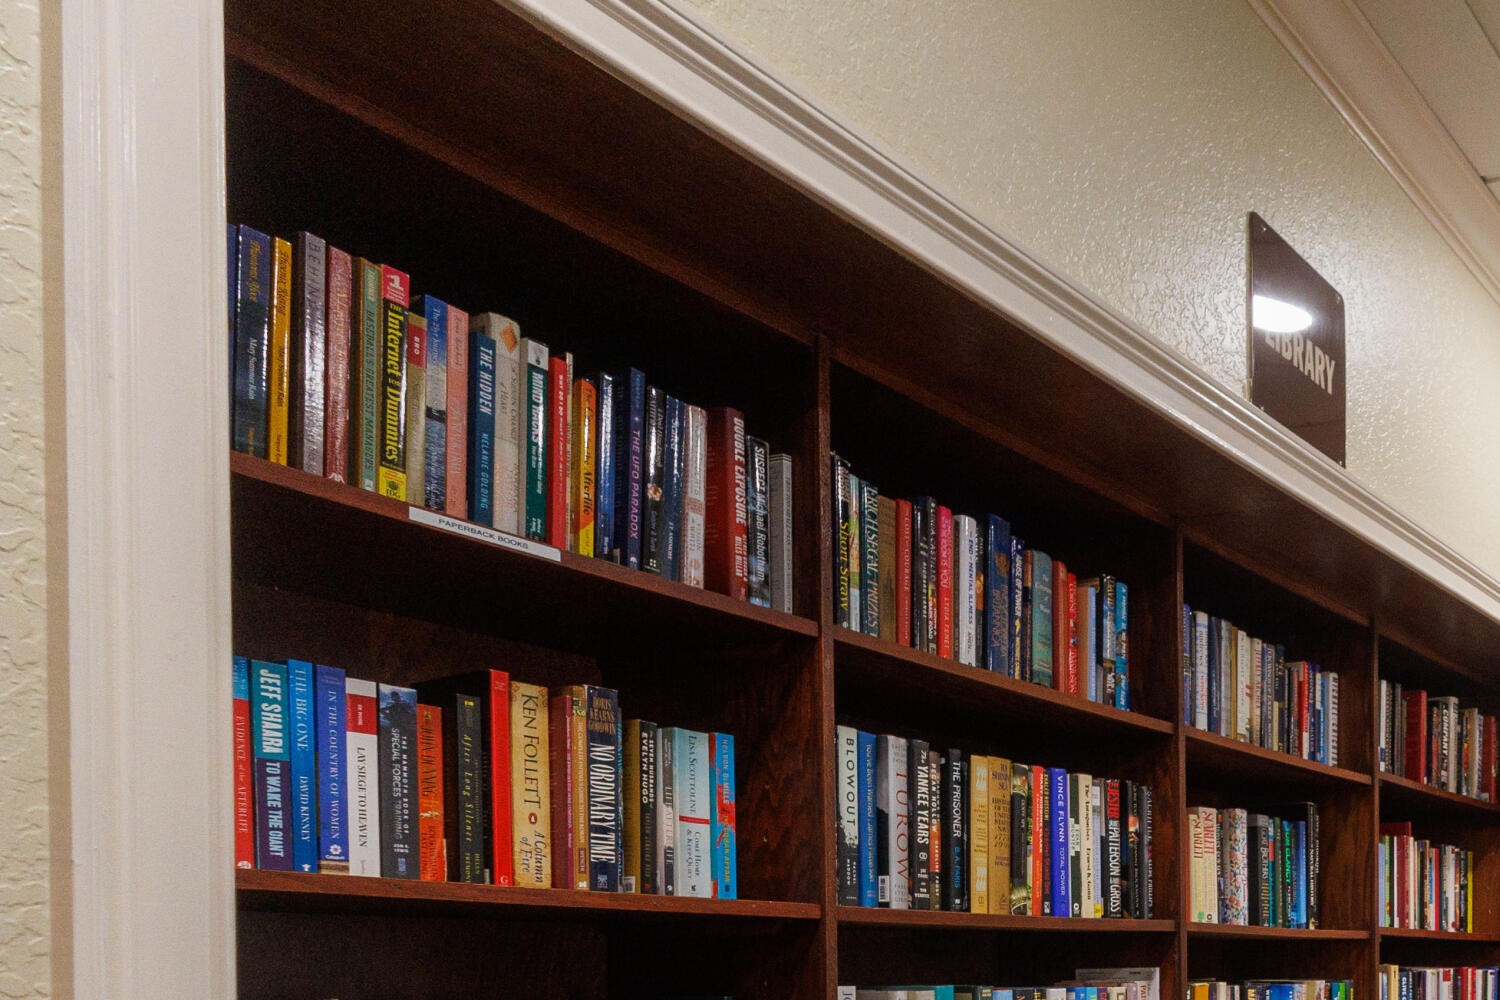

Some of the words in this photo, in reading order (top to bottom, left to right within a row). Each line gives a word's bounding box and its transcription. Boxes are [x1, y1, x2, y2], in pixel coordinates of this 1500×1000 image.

[388, 312, 405, 376] Internet
[480, 347, 493, 366] THE
[1265, 331, 1336, 395] LIBRARY
[480, 373, 493, 416] HIDDEN
[532, 372, 544, 403] MIND
[385, 388, 402, 463] Dummies
[532, 405, 544, 443] HACKS
[630, 429, 640, 449] THE
[733, 417, 746, 461] DOUBLE
[480, 433, 489, 470] MELANIE
[630, 455, 640, 479] UFO
[480, 472, 489, 509] GOLDING
[733, 466, 746, 525] EXPOSURE
[630, 482, 640, 539] PARADOX
[438, 518, 495, 540] PAPERBACK
[498, 535, 529, 549] BOOKS
[840, 522, 849, 561] Short
[840, 566, 849, 611] Straw
[260, 670, 280, 700] JEFF
[328, 690, 337, 701] IN
[261, 703, 283, 753] SHAARA
[329, 706, 338, 726] THE
[522, 694, 539, 730] KEN
[266, 762, 279, 774] TO
[329, 730, 338, 779] COUNTRY
[589, 743, 616, 762] NO
[524, 735, 541, 808] FOLLETT
[846, 738, 855, 826] BLOWOUT
[917, 766, 929, 807] YANKEE
[952, 762, 961, 782] THE
[267, 776, 281, 807] WAKE
[300, 776, 309, 804] DAVID
[330, 783, 339, 797] OF
[589, 764, 616, 830] ORDINARY
[268, 810, 282, 828] THE
[301, 807, 310, 842] KINNEY
[331, 800, 340, 839] WOMEN
[917, 810, 929, 844] YEARS
[952, 785, 961, 837] PRISONER
[269, 830, 284, 857] GIANT
[589, 833, 616, 863] TIME
[1109, 827, 1121, 876] PATTERSON
[1109, 885, 1121, 912] GROSS
